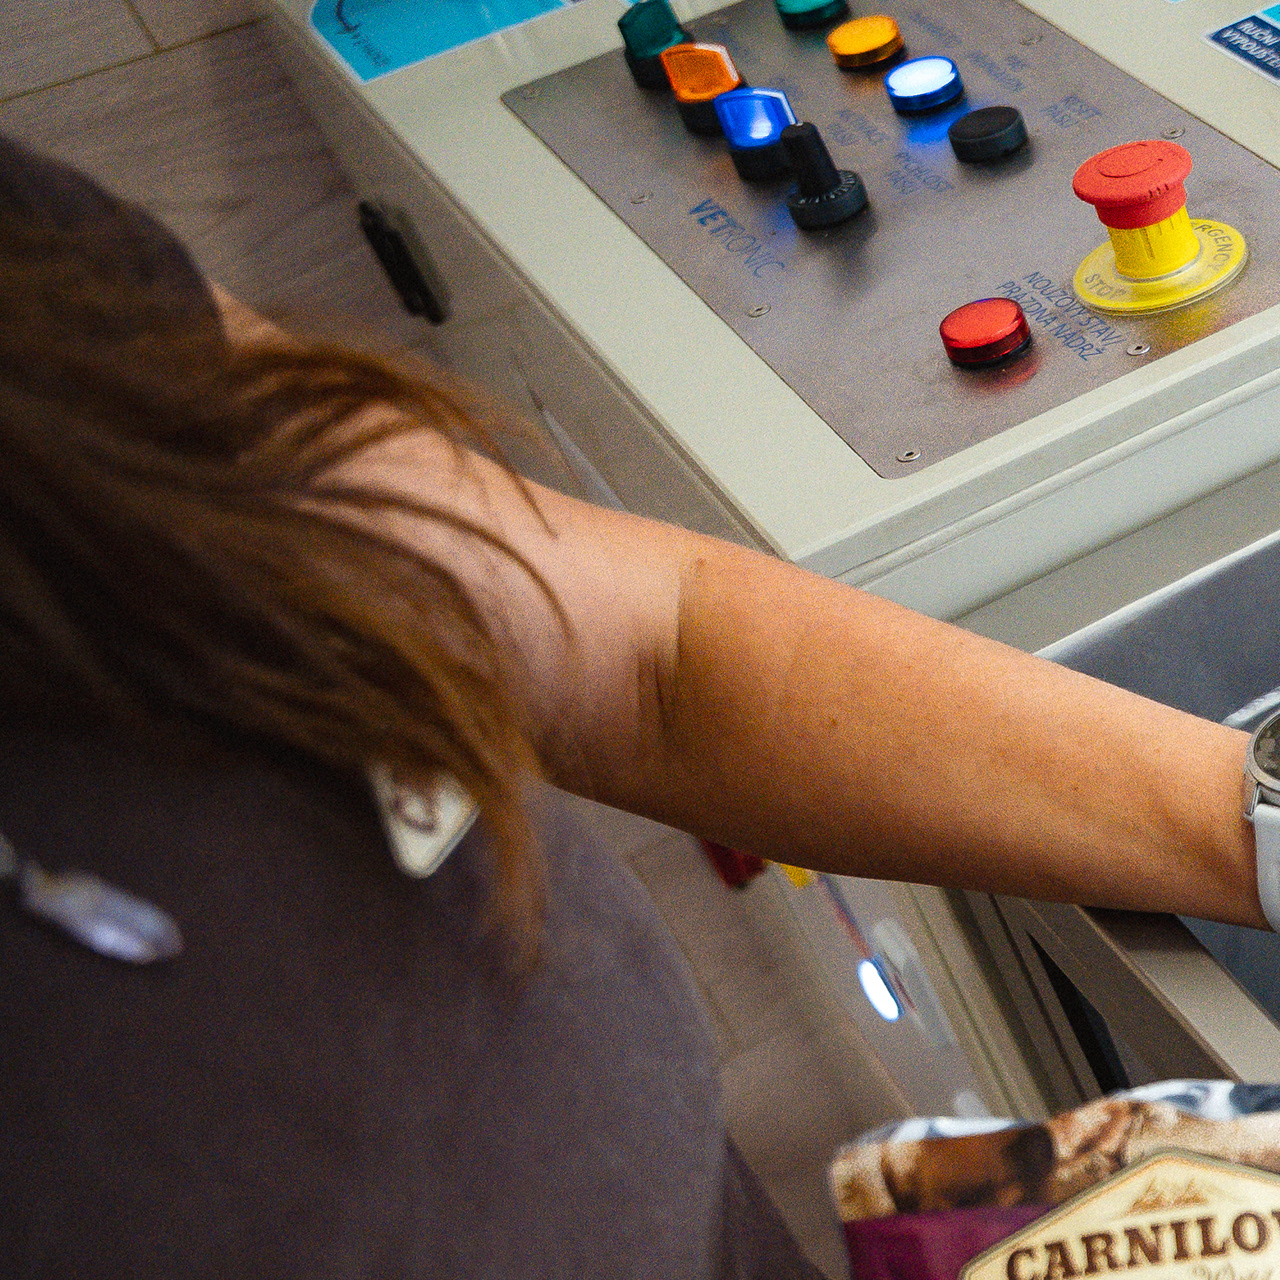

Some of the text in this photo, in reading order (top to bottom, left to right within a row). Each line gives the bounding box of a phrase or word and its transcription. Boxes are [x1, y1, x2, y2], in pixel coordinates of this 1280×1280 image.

[688, 198, 786, 279] VETRONIC
[1190, 221, 1234, 272] RGENCY
[1084, 273, 1127, 301] STOP
